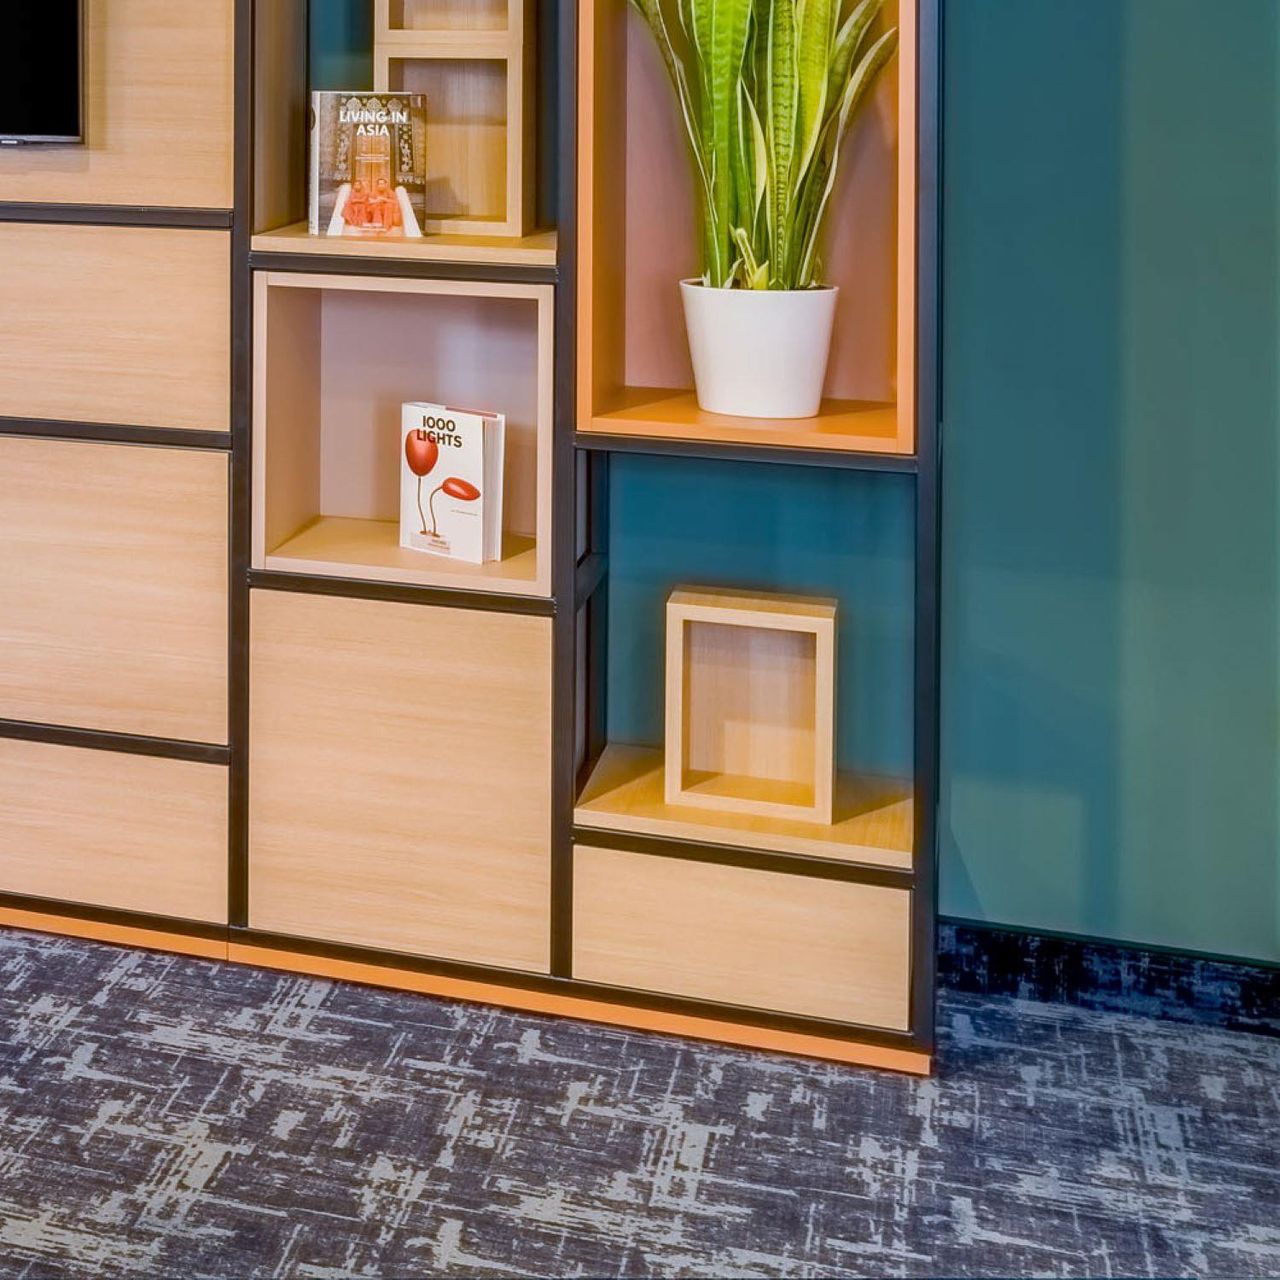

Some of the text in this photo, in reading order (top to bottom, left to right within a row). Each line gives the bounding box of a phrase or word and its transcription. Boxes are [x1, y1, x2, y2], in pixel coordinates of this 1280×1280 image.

[339, 110, 407, 123] LIVING IN
[356, 124, 390, 136] ASIA
[422, 415, 457, 432] 1000
[416, 429, 463, 449] LIGHTS
